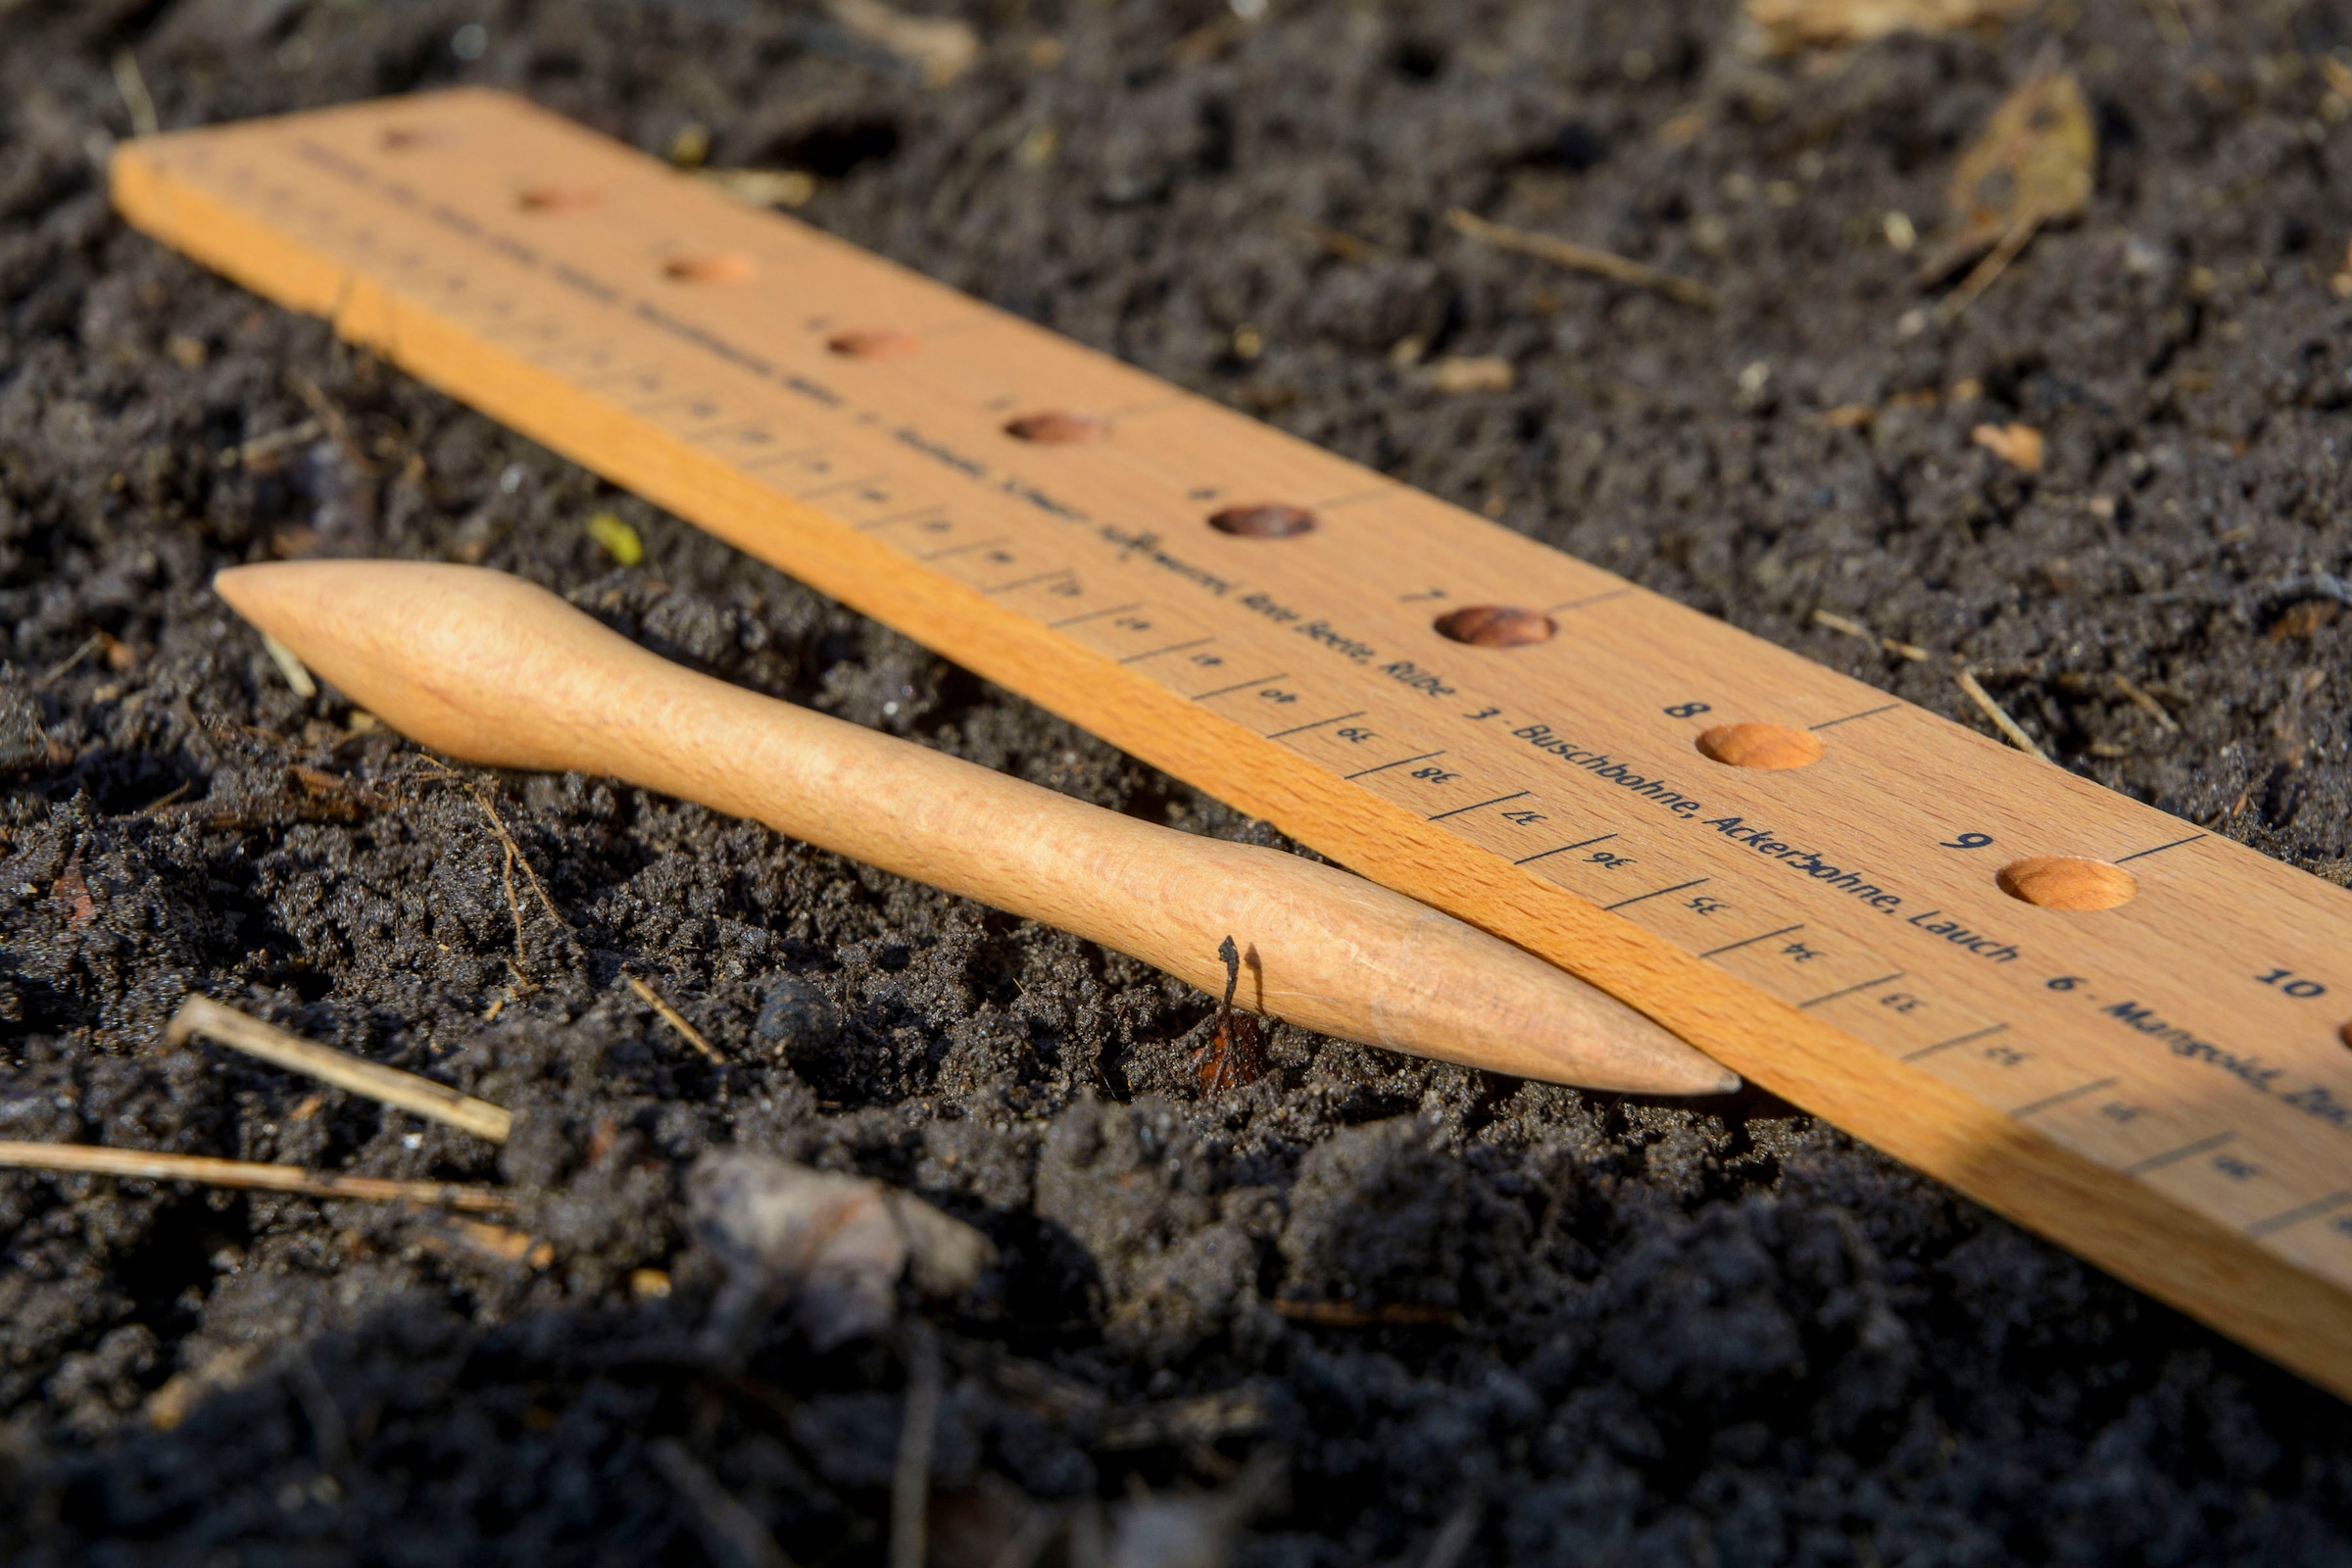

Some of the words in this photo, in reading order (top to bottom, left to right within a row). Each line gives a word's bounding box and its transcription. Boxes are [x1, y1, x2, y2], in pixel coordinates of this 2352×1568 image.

[1663, 701, 1713, 719] 8
[1336, 726, 1383, 744] 39
[1412, 766, 1463, 786] 38
[1500, 810, 1550, 827] 37
[1461, 706, 1501, 720] 3
[1511, 723, 1701, 819] Buschbohne,
[1701, 816, 1903, 914] Ackerbohne,
[1907, 909, 2020, 963] Lauch
[2045, 975, 2087, 992] 6
[1938, 831, 1995, 851] 9
[1583, 850, 1641, 871] 36
[1683, 896, 1733, 917] 35
[1781, 942, 1827, 964] 34
[2253, 966, 2328, 1000] 10
